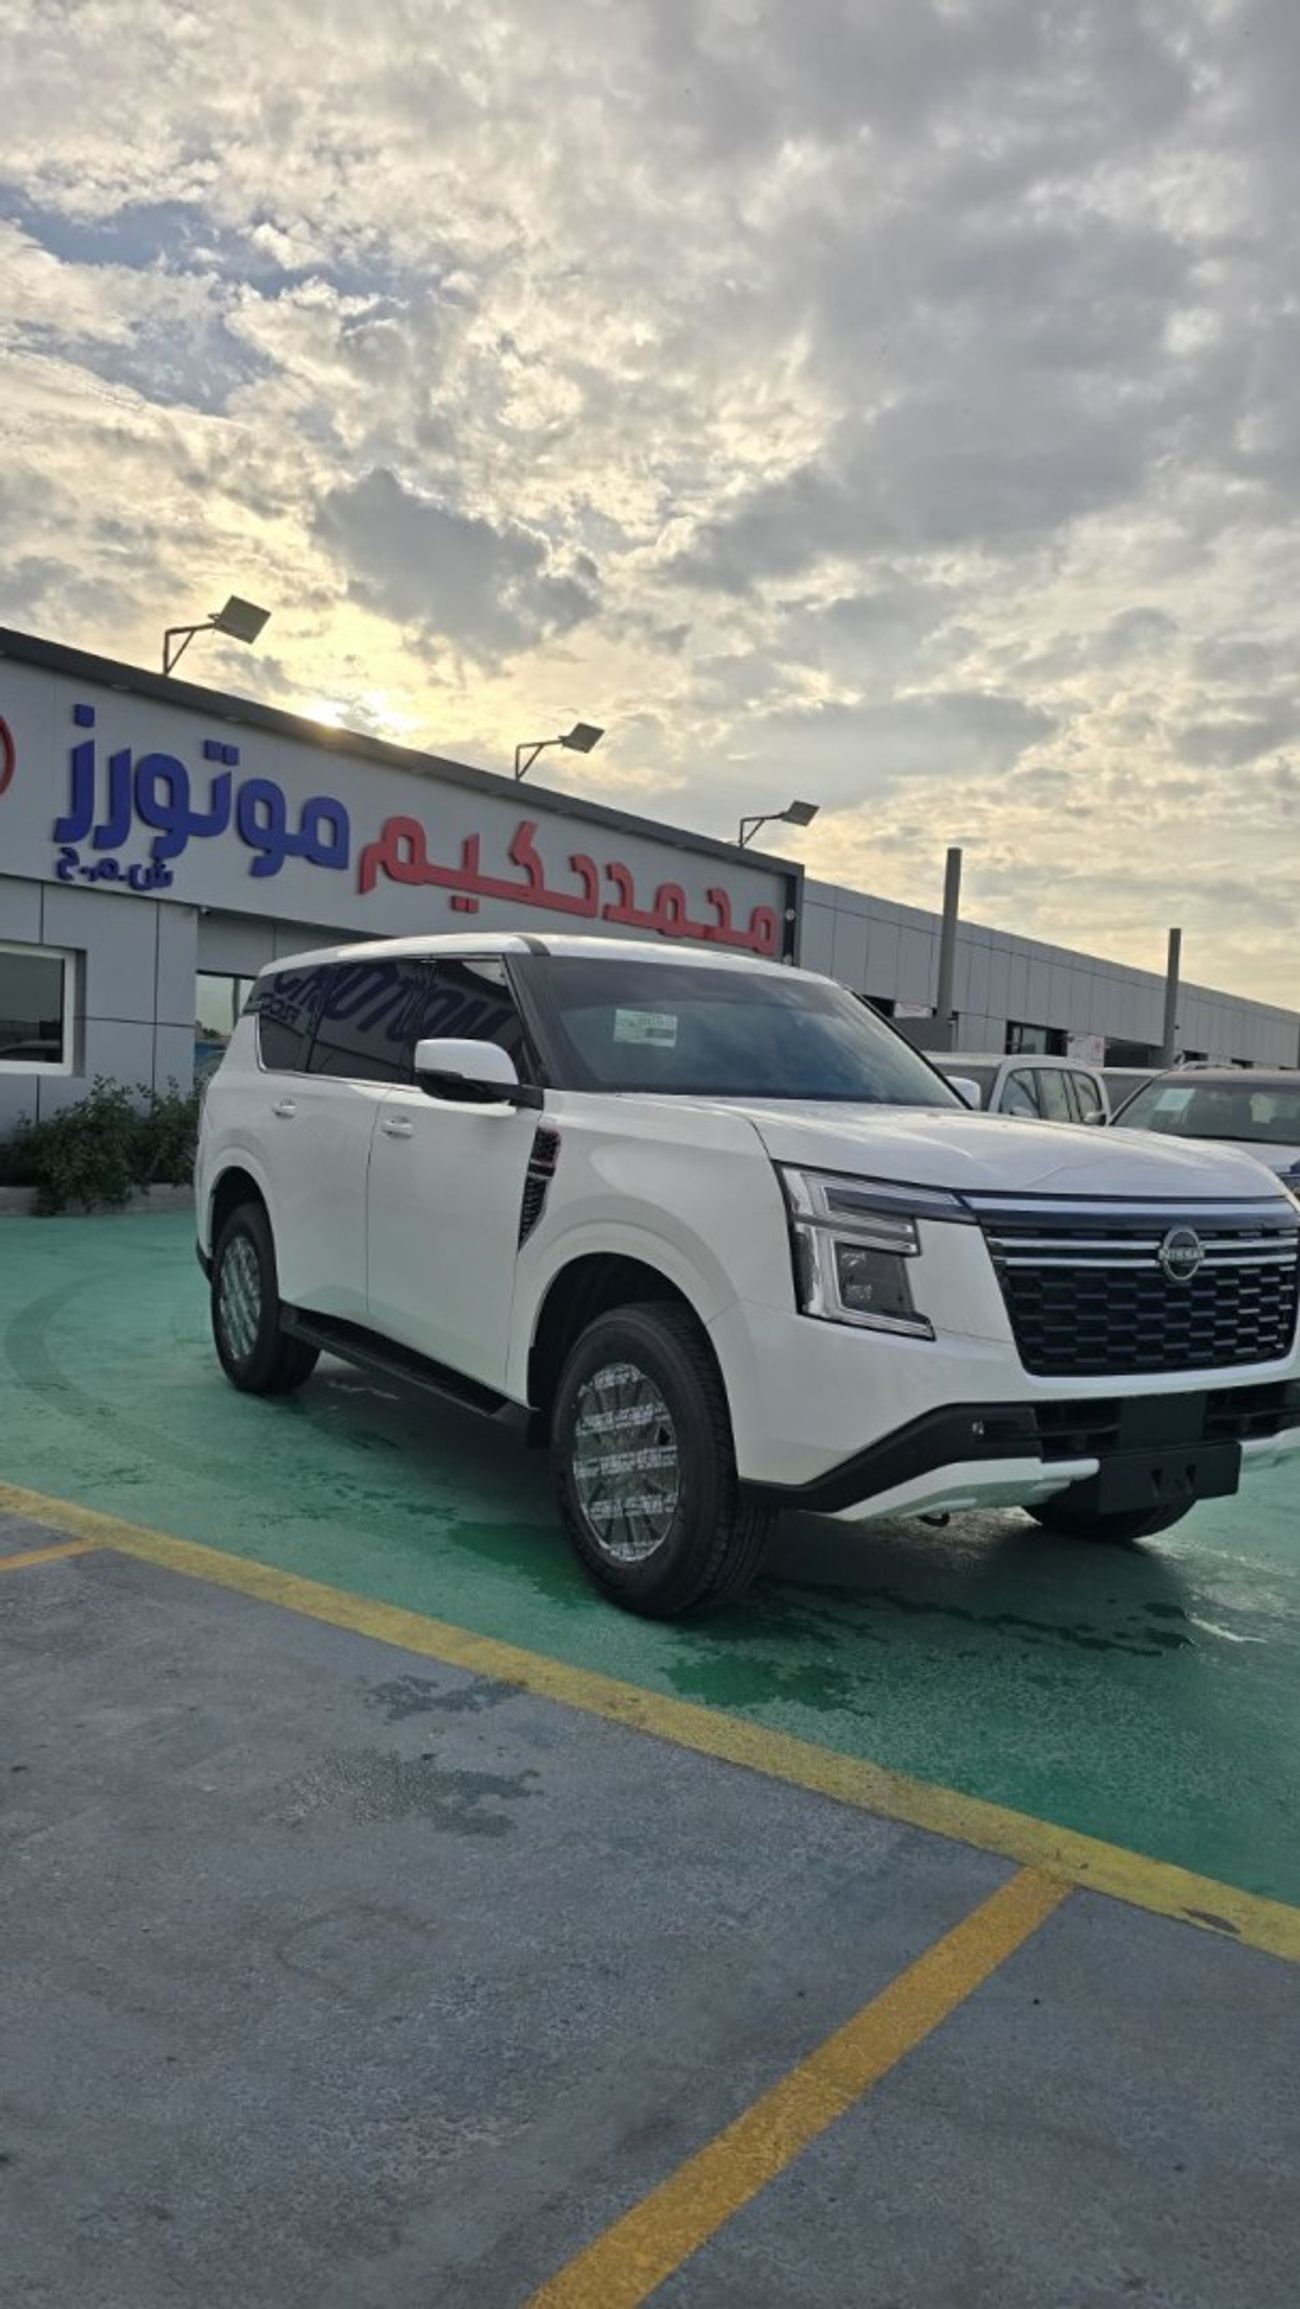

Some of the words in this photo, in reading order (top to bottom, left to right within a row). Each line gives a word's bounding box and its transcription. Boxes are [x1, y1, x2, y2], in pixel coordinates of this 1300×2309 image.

[54, 703, 352, 878] موتورز
[358, 816, 599, 918] حكيم
[603, 861, 779, 955] محمد
